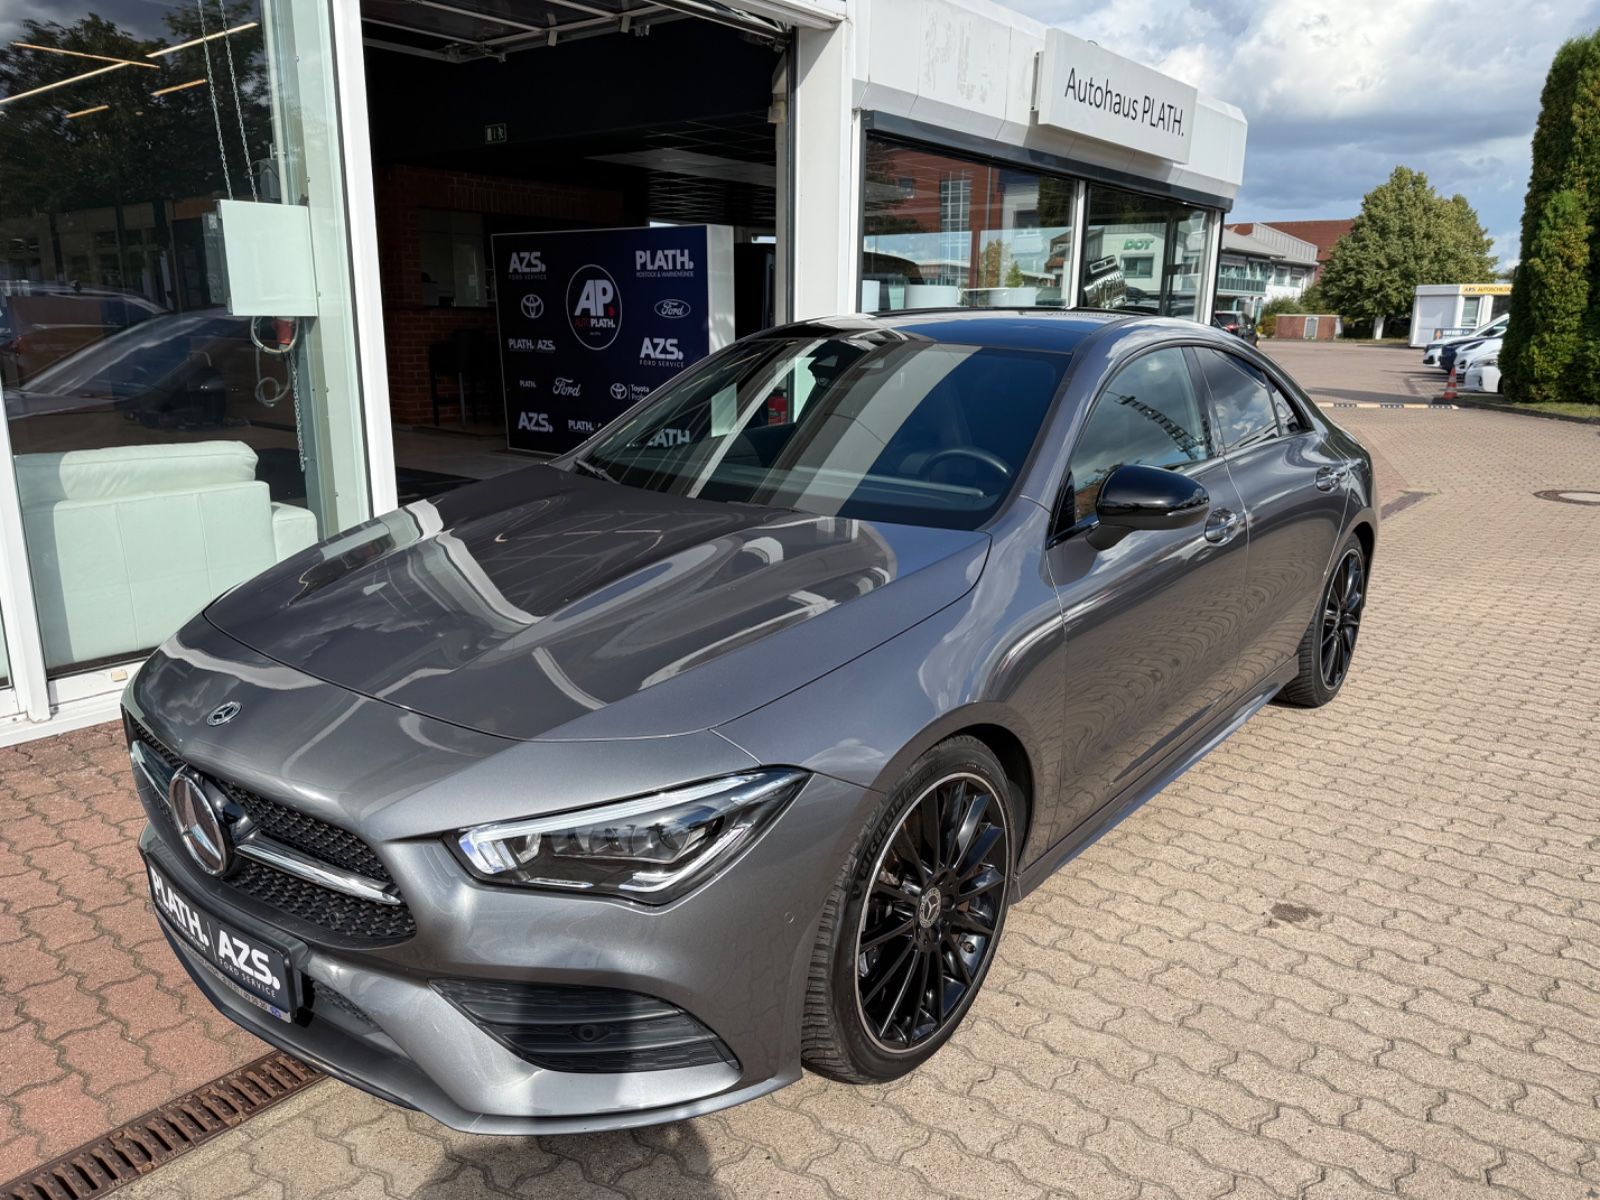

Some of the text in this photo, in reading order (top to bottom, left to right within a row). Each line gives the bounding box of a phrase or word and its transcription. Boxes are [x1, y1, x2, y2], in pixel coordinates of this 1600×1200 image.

[1065, 68, 1185, 137] Autohaus PLATH.
[508, 251, 547, 273] AZS.
[635, 249, 694, 271] PLATH.
[660, 301, 685, 316] Ford
[640, 337, 684, 360] AZS.
[658, 360, 684, 368] SERVICE
[552, 377, 581, 397] Ford
[631, 384, 650, 394] Toyota
[518, 411, 554, 433] AZS.
[149, 865, 210, 948] PLATH.
[218, 930, 281, 990] AZS.
[241, 973, 277, 998] SERVICE
